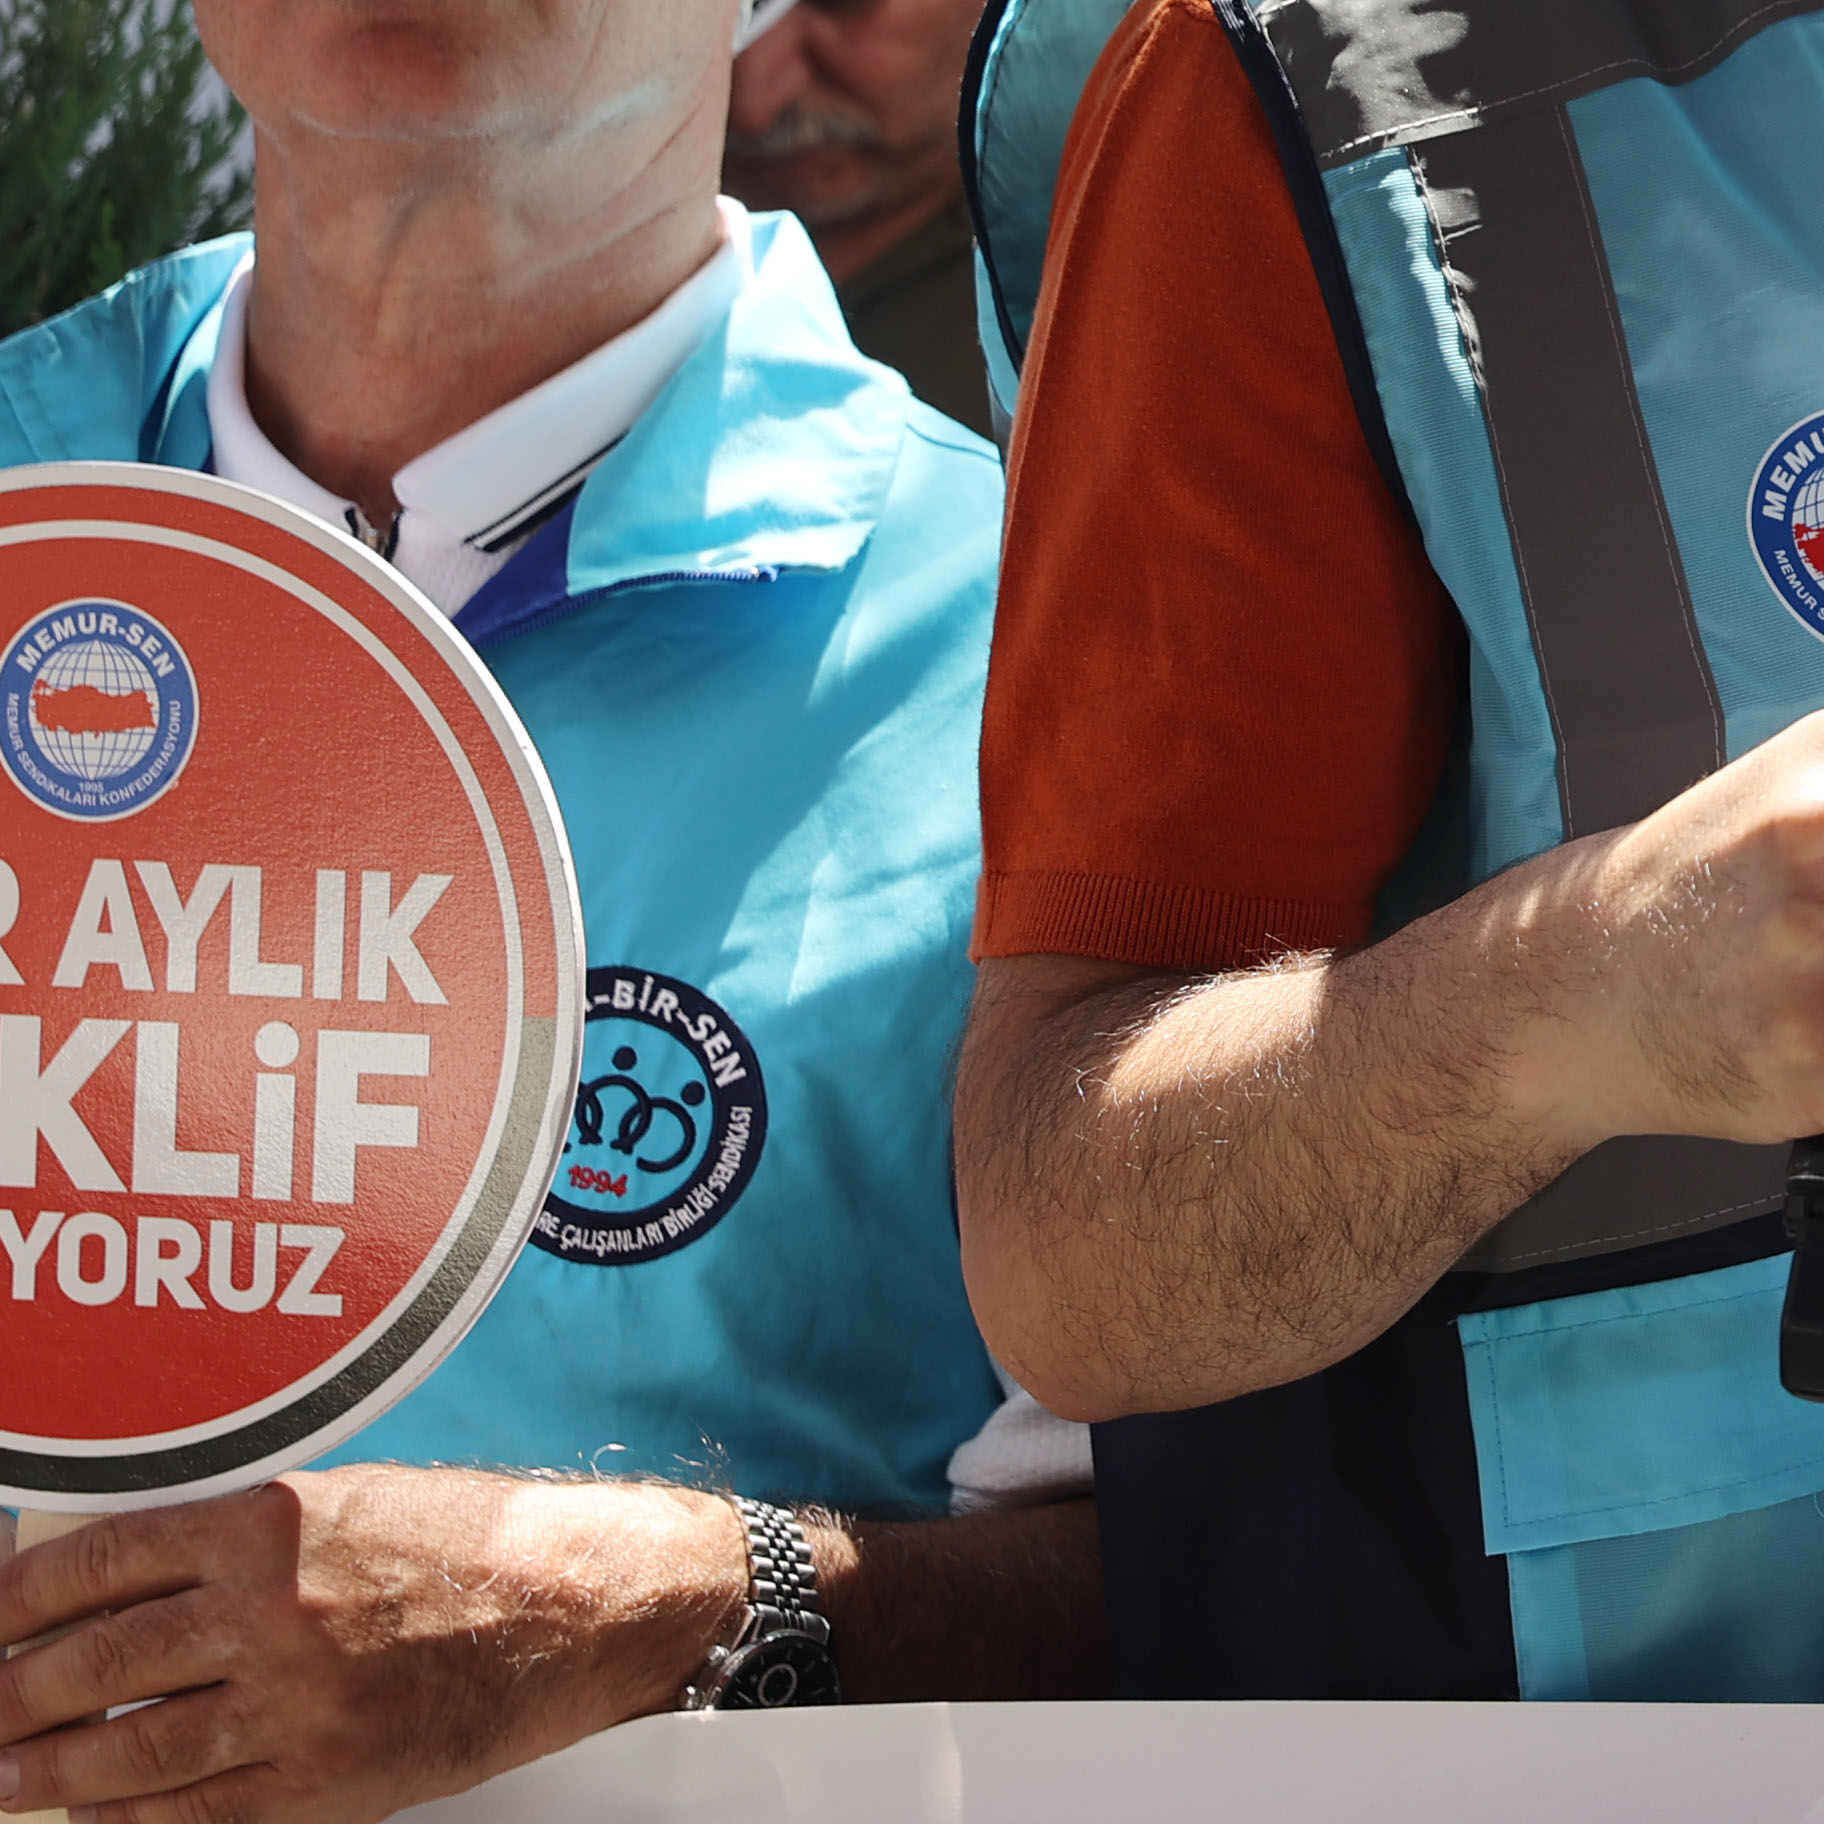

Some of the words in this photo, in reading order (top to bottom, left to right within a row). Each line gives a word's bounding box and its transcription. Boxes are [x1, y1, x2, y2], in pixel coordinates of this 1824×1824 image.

[1774, 549, 1818, 611] MEMUR
[16, 611, 176, 678] MEMUR-SEN
[6, 691, 25, 752] MEMUR
[99, 699, 182, 807] KONFEDERASYONU
[52, 858, 455, 1006] AYLIK
[585, 974, 748, 1089] -BİR-SEN
[568, 1164, 628, 1198] 1994
